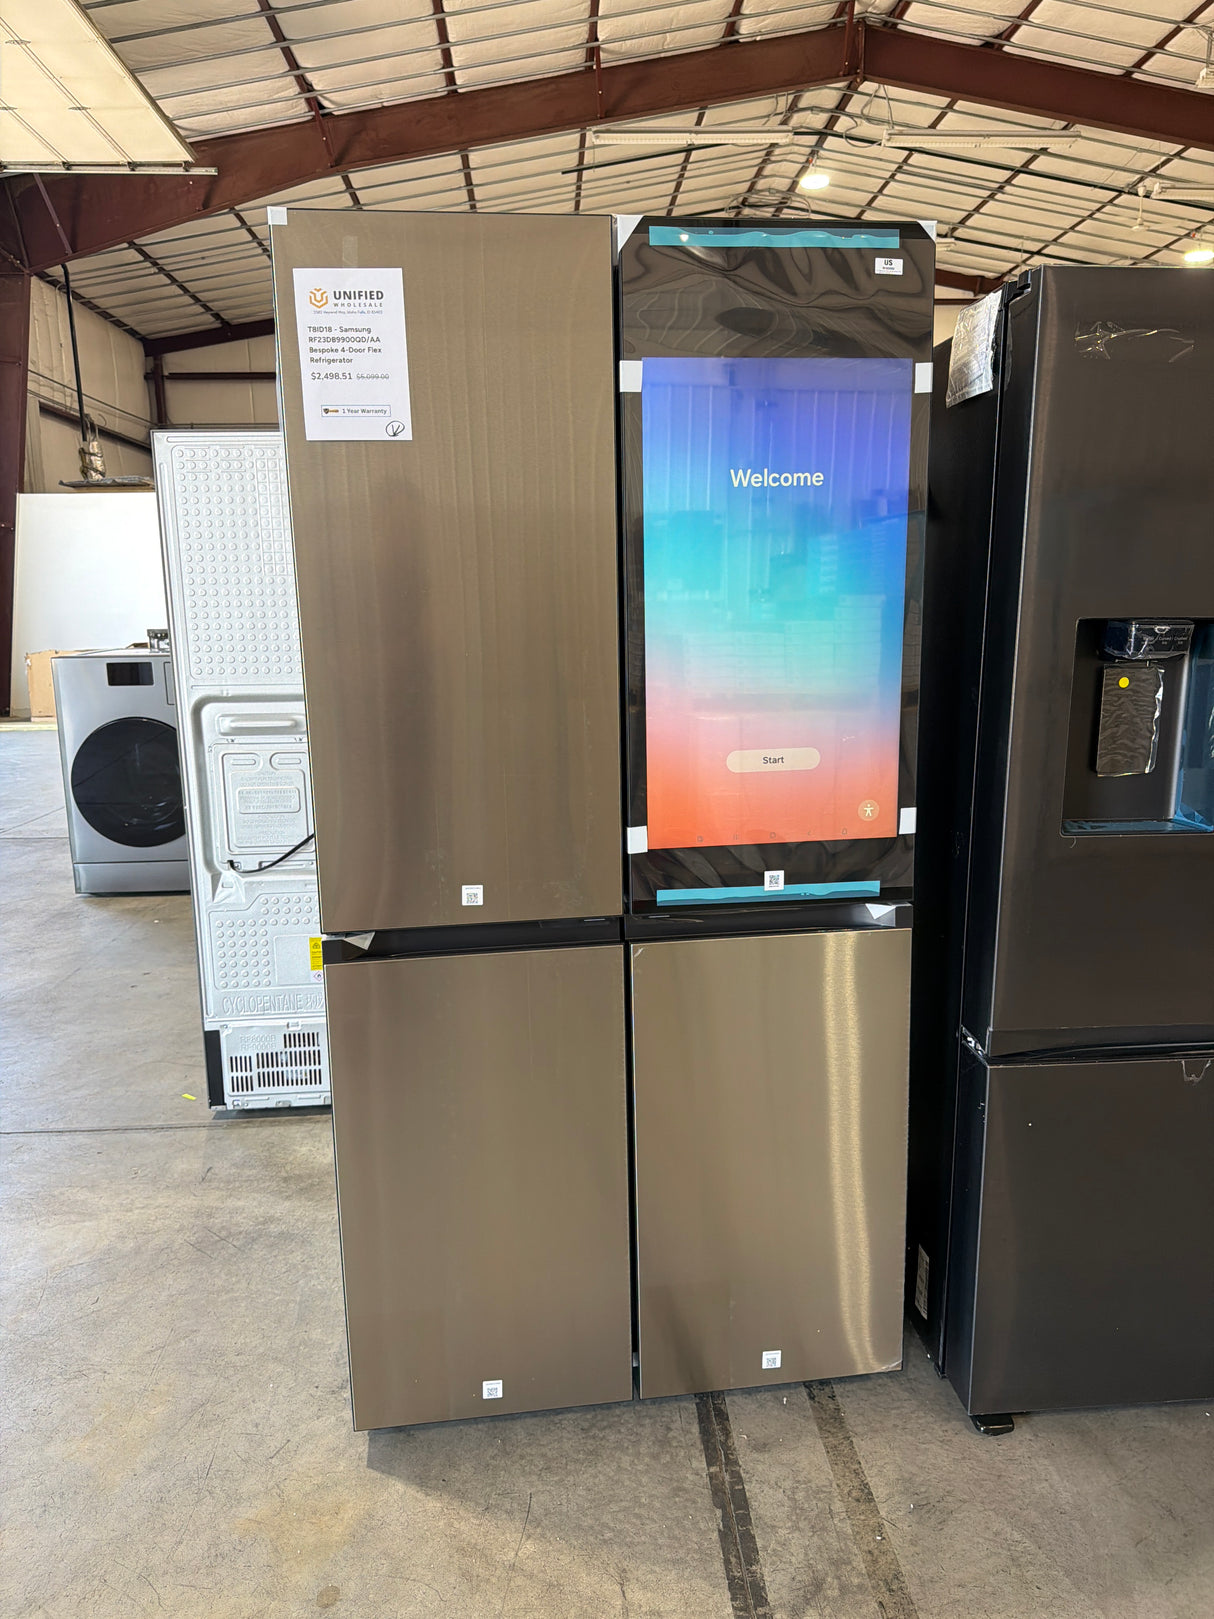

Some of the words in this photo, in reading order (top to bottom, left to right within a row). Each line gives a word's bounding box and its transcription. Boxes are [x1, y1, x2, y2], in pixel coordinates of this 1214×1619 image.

[333, 290, 384, 301] UNIFIED
[339, 326, 372, 334] Samsung
[309, 357, 353, 365] Refrigerator
[311, 372, 353, 381] $2,498.51
[730, 467, 824, 488] Welcome
[762, 756, 785, 765] Start
[222, 993, 304, 1016] CYCLOPENTANE
